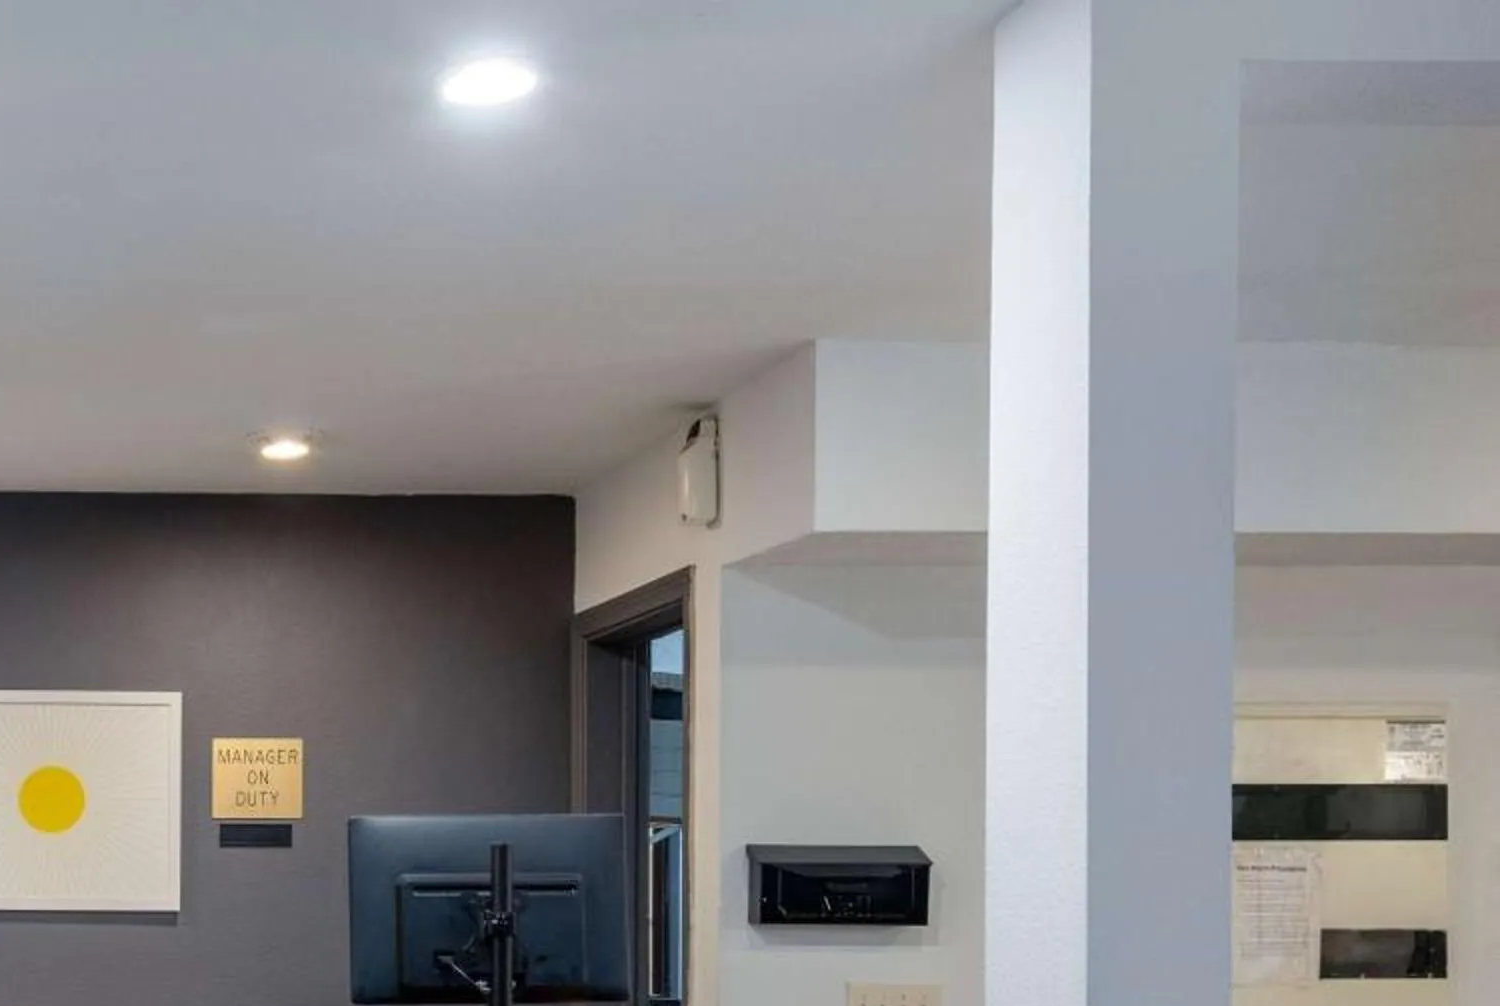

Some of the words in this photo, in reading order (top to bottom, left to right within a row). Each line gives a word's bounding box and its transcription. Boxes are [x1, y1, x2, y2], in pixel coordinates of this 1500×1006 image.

[217, 748, 299, 765] MANAGER
[247, 769, 269, 785] ON
[235, 790, 279, 807] DUTY
